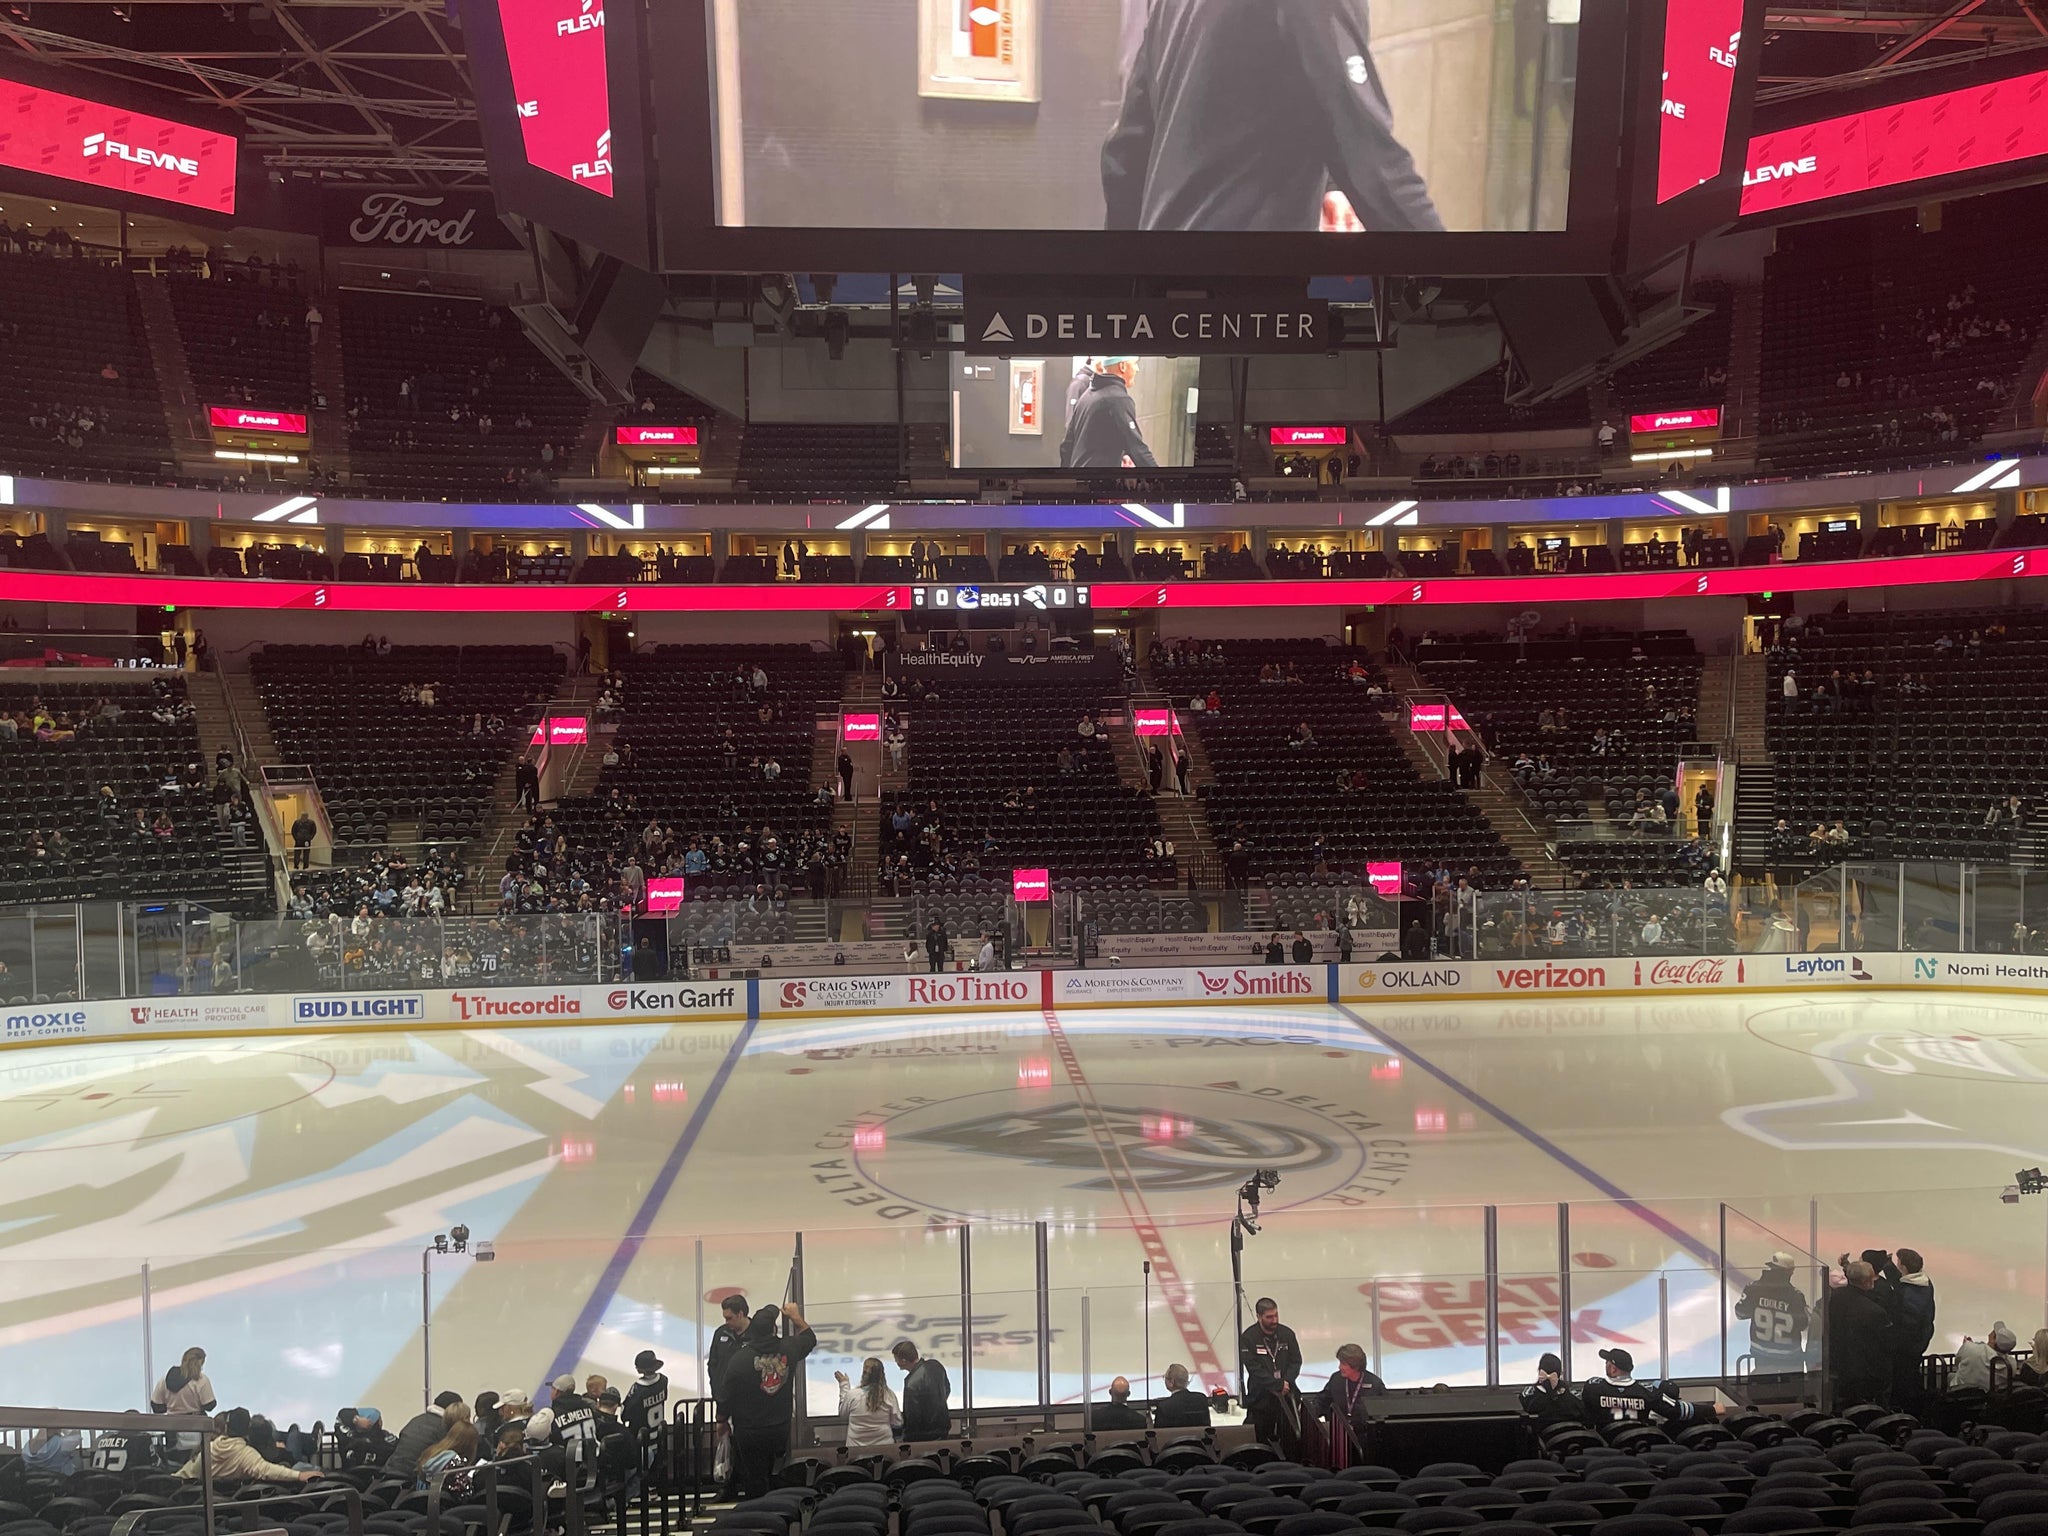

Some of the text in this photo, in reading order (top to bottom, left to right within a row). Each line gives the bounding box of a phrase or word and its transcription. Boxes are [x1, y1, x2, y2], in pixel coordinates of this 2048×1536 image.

[105, 140, 199, 176] FILEVINE
[350, 192, 475, 245] Ford
[1026, 313, 1314, 339] DELTA CENTER
[936, 588, 949, 607] 0
[980, 593, 1020, 607] 20:51
[1053, 588, 1067, 606] 0
[900, 653, 984, 667] HealthEquity
[1496, 963, 1605, 988] verizon
[1651, 958, 1728, 985] Coca-Cola
[1785, 957, 1845, 976] Layton
[1948, 964, 2048, 978] Nomi Health
[809, 979, 891, 992] CRAIG SWAPP
[1234, 969, 1312, 995] Smith's
[1382, 970, 1460, 988] OKLAND
[630, 987, 735, 1009] Ken Garff
[826, 990, 884, 1000] ASSOCIATES
[154, 1008, 198, 1018] HEALTH
[204, 1005, 266, 1014] OFFICIAL CARE
[299, 998, 418, 1018] BUD LIGHT
[471, 994, 580, 1016] Trucordia
[6, 1011, 87, 1030] moxie
[37, 1026, 87, 1035] CONTROL
[1358, 1276, 1560, 1312] SEAT
[1380, 1309, 1646, 1350] GEEK
[1754, 1306, 1795, 1345] 92
[1600, 1395, 1646, 1410] GUENTHER
